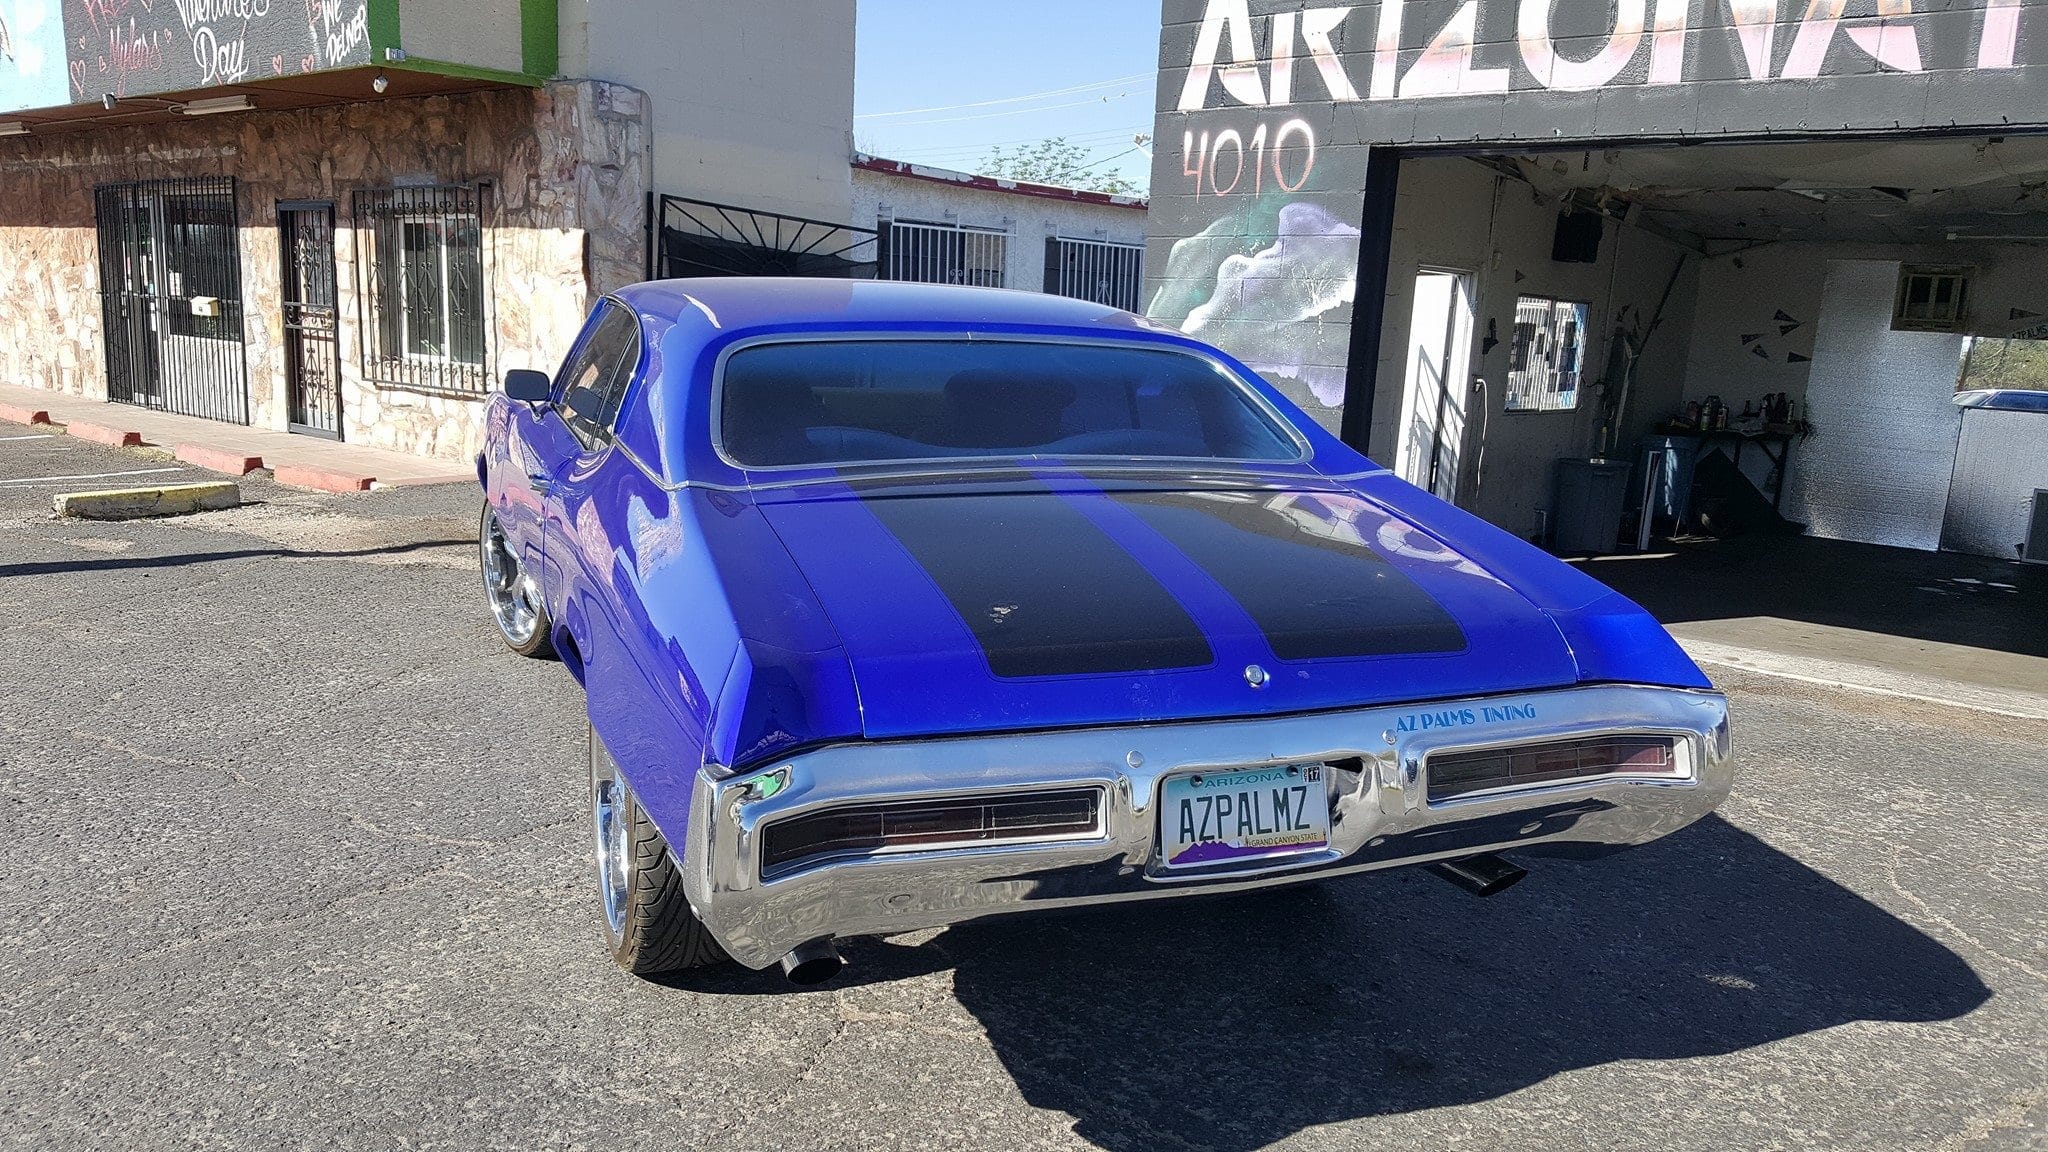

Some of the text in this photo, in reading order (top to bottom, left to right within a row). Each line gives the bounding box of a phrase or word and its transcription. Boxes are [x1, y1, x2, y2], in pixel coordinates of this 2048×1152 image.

[193, 27, 249, 85] Day
[1177, 0, 1922, 111] ARIZONA
[1183, 119, 1315, 203] 4010
[1396, 715, 1418, 733] AZ
[1420, 708, 1476, 729] PALMS
[1205, 772, 1284, 788] ARIZONA
[1308, 767, 1320, 782] 17
[1180, 786, 1310, 844] AZPALMZ
[1252, 832, 1318, 846] GRAND CANYON STATE
